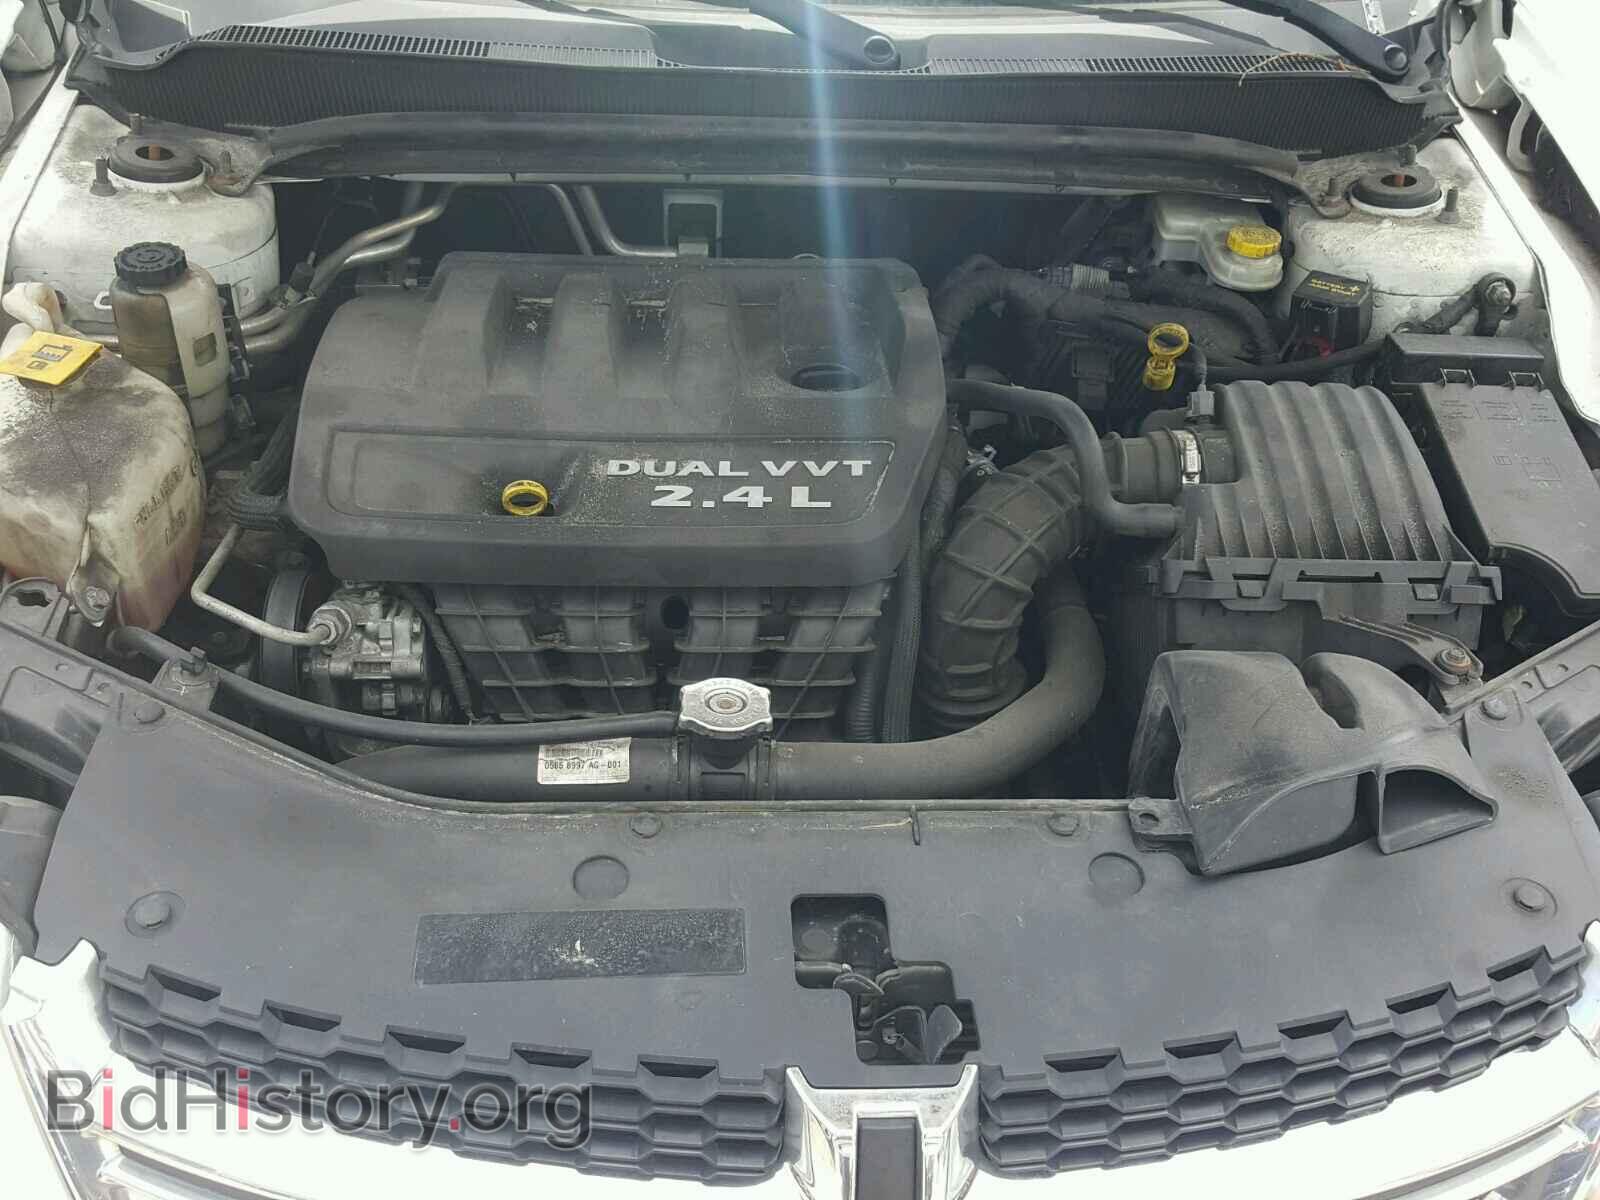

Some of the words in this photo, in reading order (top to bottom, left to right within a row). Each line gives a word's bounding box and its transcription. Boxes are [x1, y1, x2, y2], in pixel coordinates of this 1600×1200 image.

[606, 460, 749, 477] DUAL
[760, 460, 873, 477] VVT
[650, 485, 773, 508] 2.4
[791, 486, 832, 508] L
